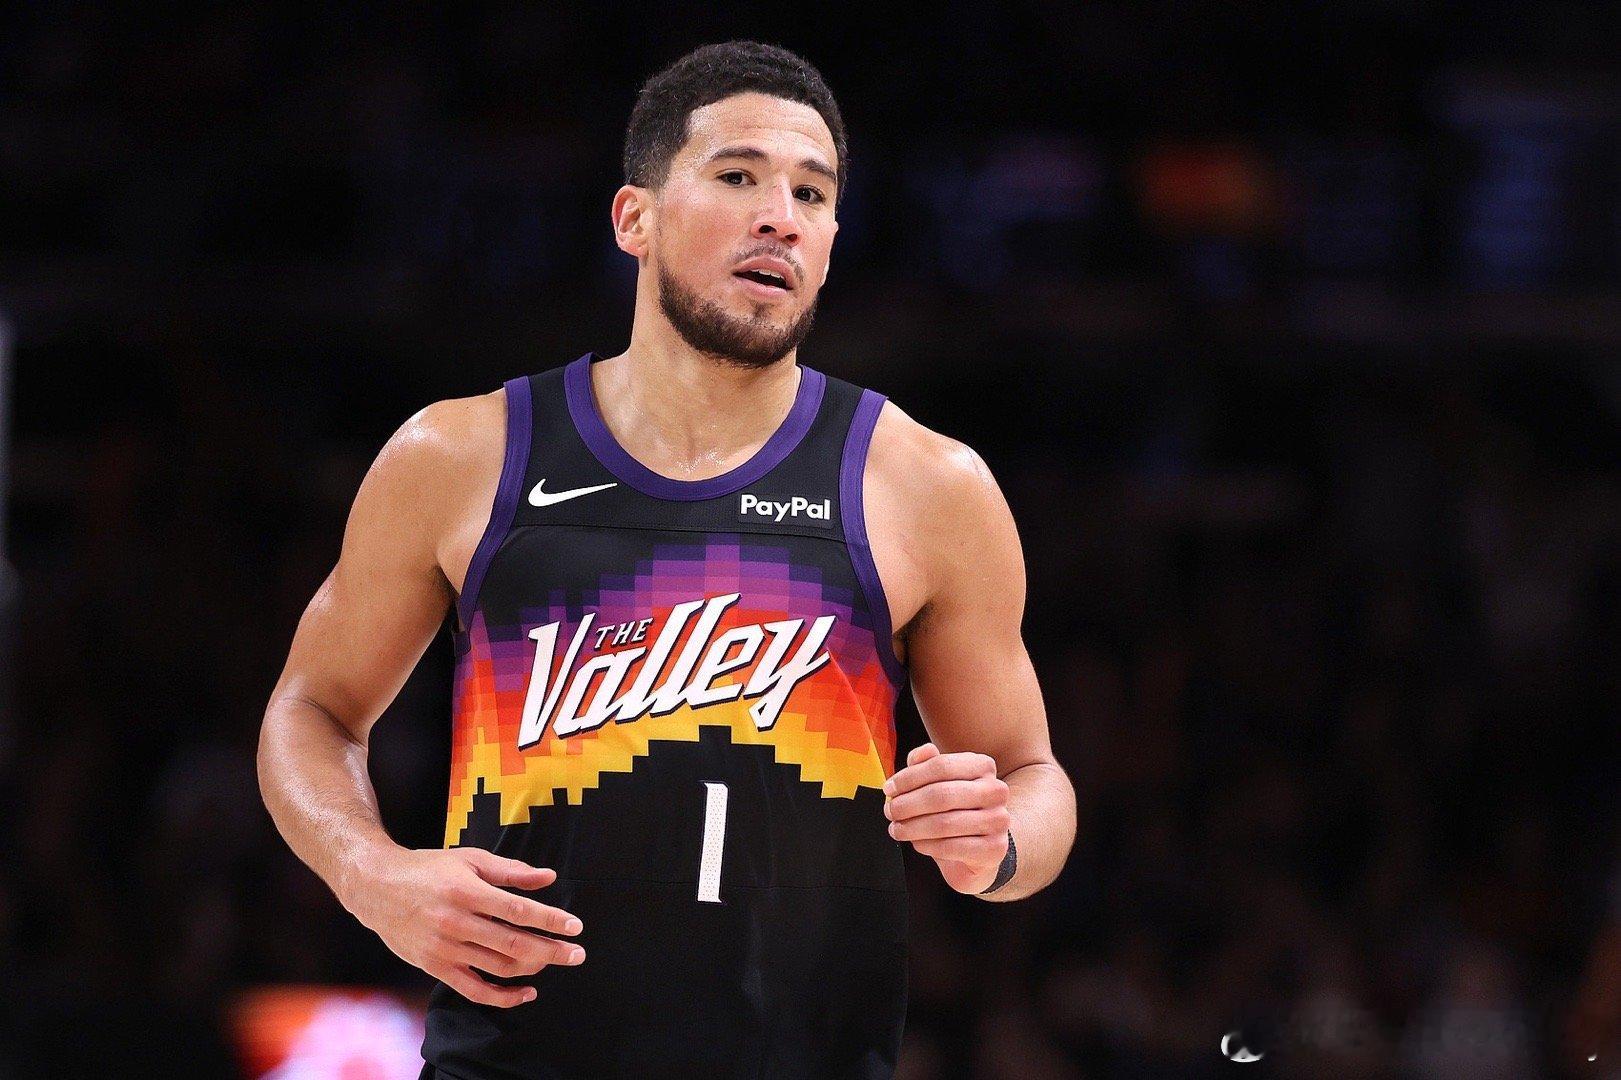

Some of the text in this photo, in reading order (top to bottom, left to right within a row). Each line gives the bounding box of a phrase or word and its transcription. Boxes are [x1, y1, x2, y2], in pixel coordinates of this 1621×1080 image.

[740, 494, 831, 522] PayPal
[518, 593, 837, 751] Valley
[594, 617, 654, 650] THE
[697, 782, 729, 904] 1
